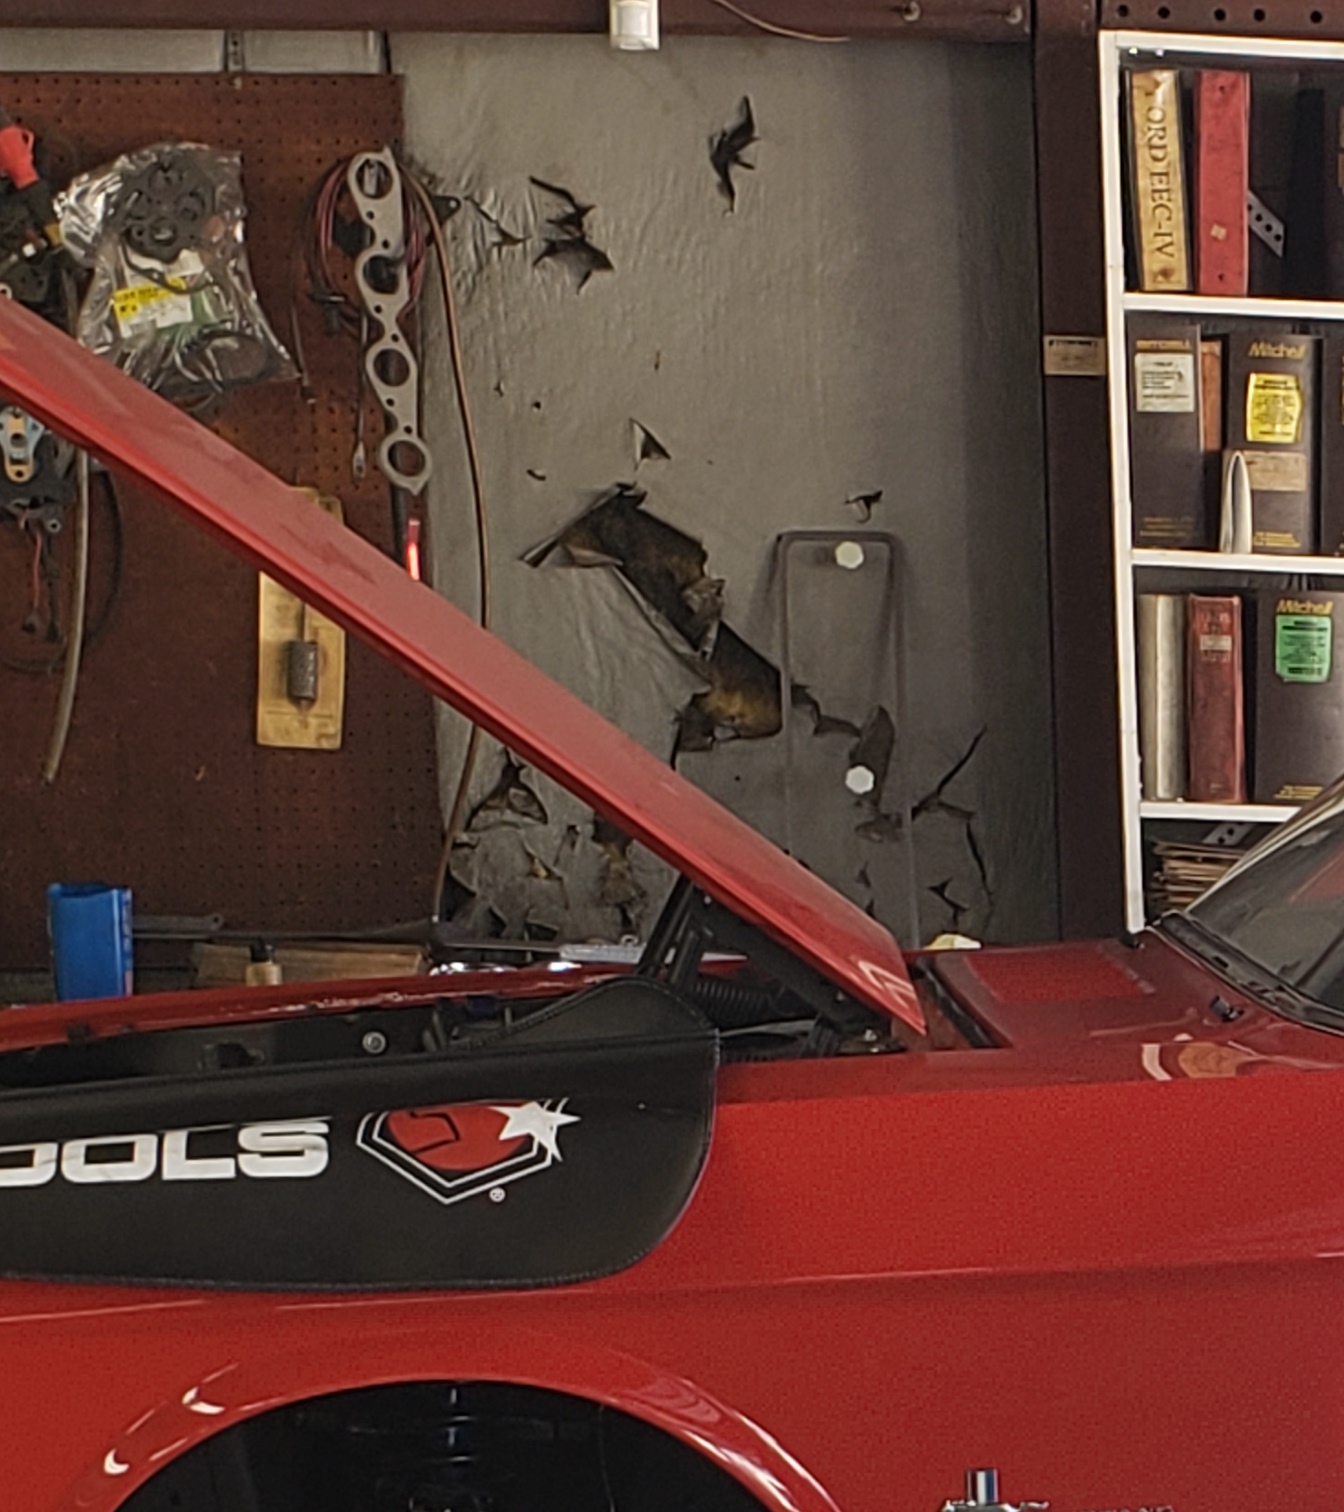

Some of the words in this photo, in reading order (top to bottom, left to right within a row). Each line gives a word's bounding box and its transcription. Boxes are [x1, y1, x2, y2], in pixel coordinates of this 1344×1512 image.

[1144, 90, 1169, 164] ORD
[1149, 170, 1176, 259] EEC-IV
[1247, 341, 1307, 360] Mitchell
[1276, 598, 1334, 615] Mitchell
